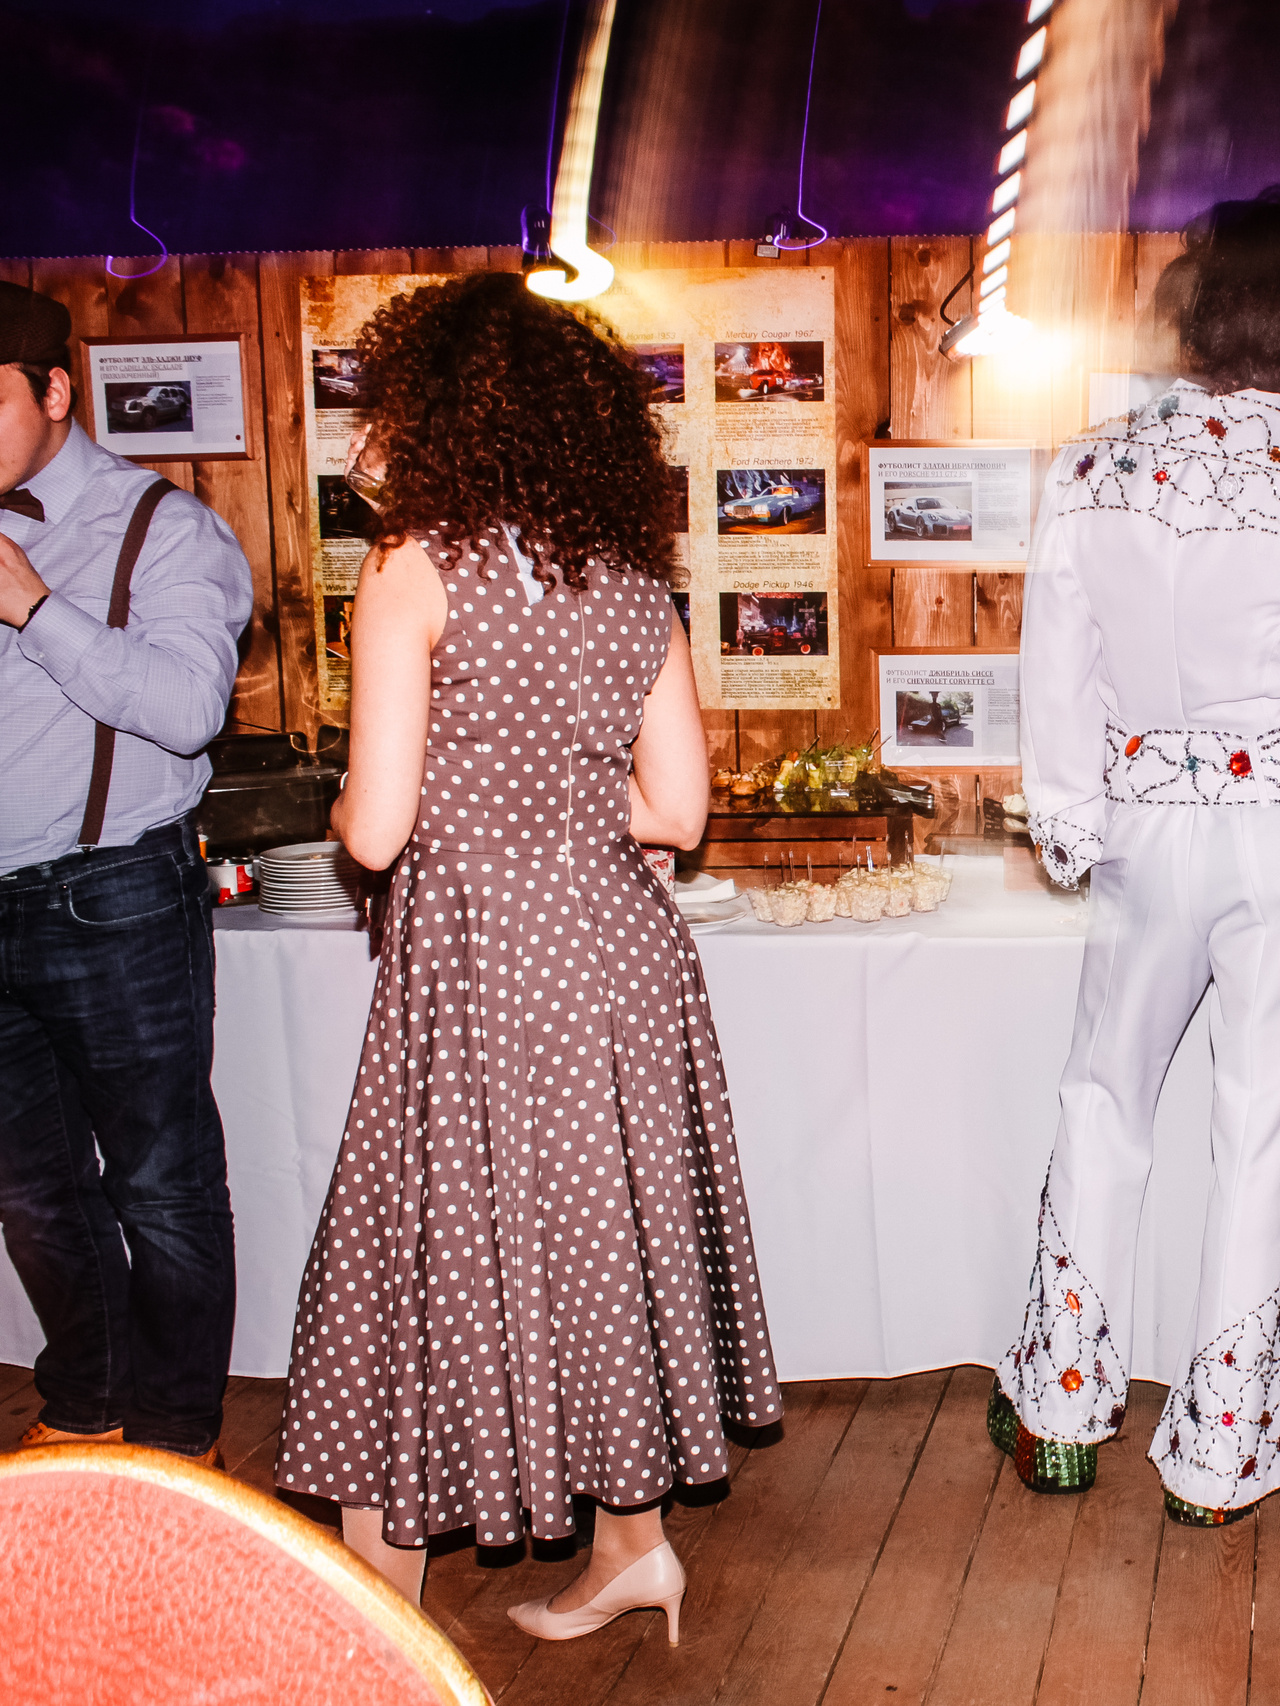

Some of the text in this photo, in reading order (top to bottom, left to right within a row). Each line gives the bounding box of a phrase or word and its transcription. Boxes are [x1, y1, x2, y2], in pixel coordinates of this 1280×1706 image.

[725, 331, 758, 339] Mercury
[761, 330, 791, 339] Cougar
[731, 457, 814, 465] Ford Ranchero 1972
[733, 580, 814, 589] Dodge Pickup 1946
